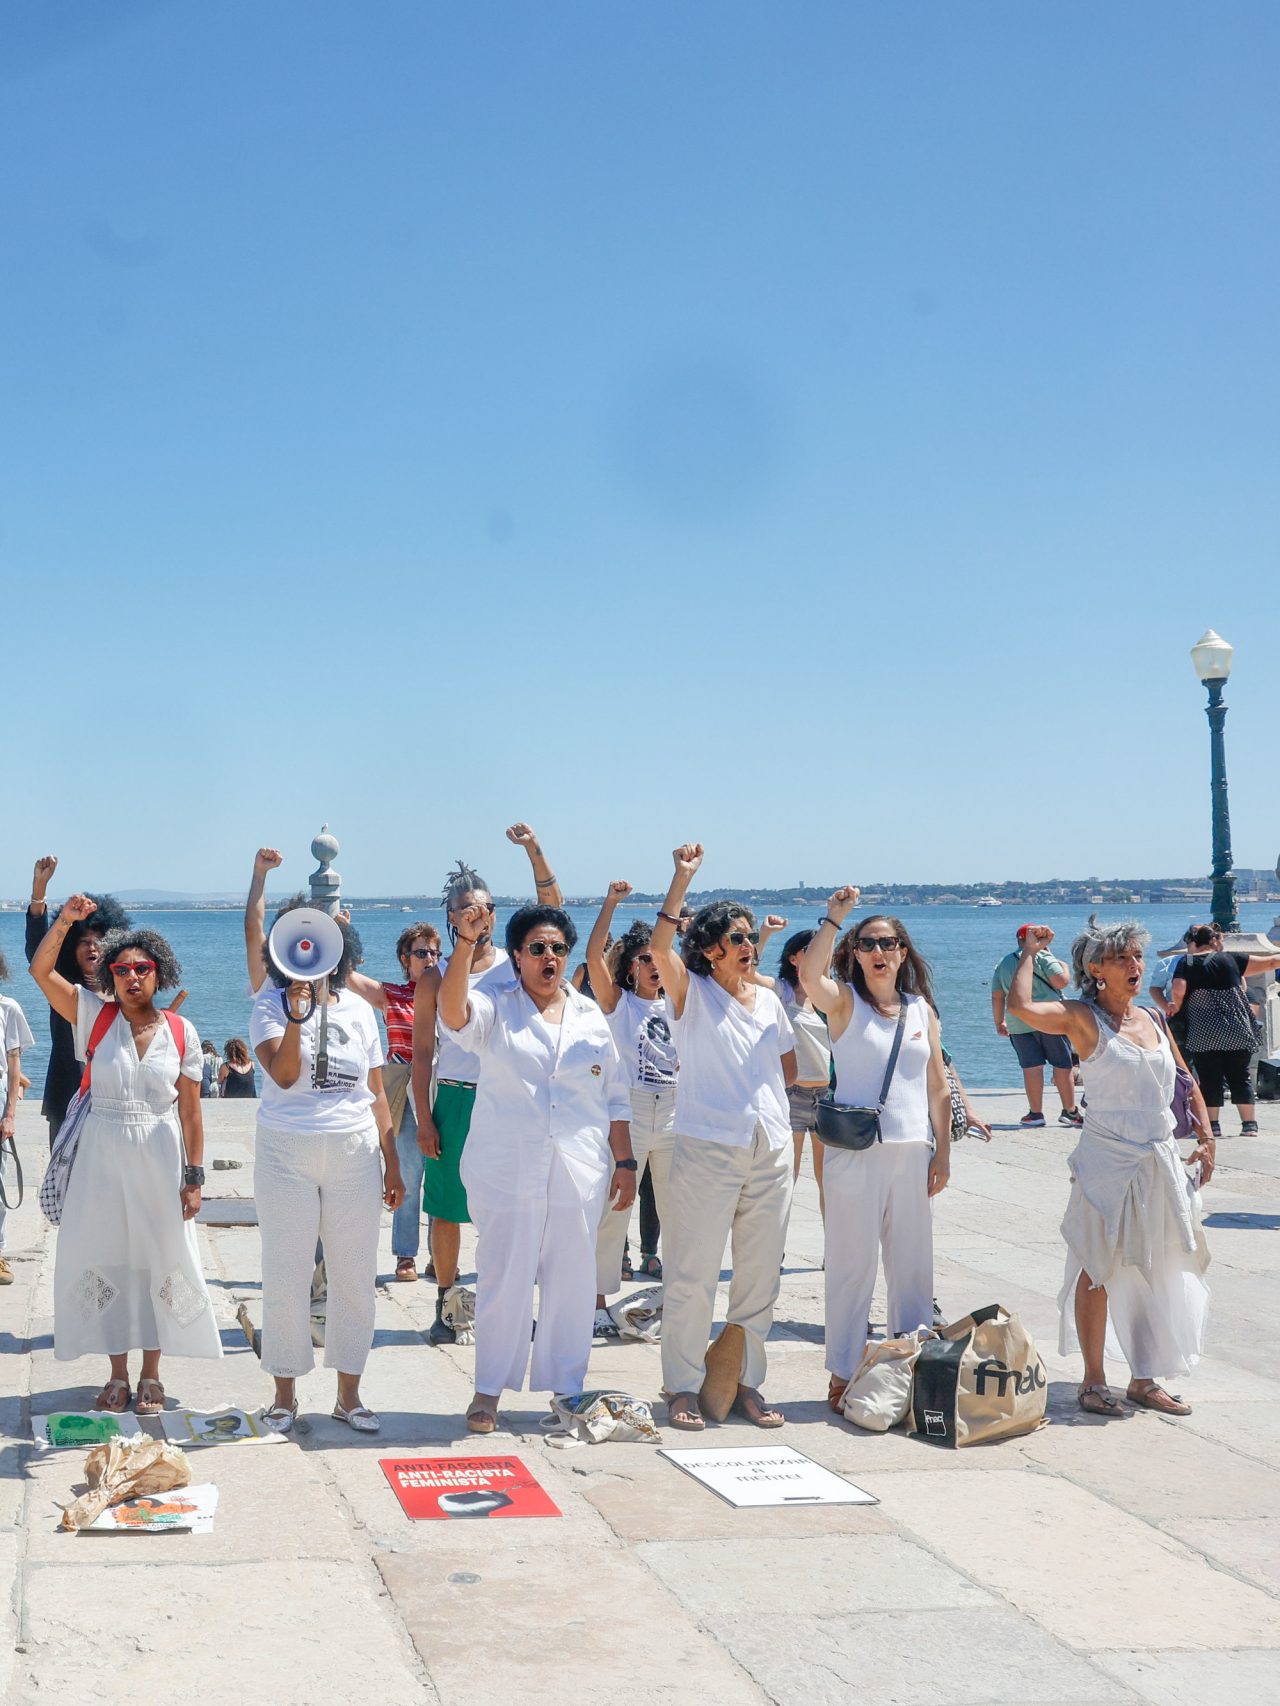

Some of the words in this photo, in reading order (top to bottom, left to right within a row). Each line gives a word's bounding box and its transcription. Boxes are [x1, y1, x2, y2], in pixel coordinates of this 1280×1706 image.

[973, 1359, 1047, 1398] fnac
[393, 1461, 517, 1472] ANTI-FASCISTA
[683, 1458, 813, 1469] DESCOLONIZAR
[398, 1469, 515, 1480] ANTI-RACISTA
[400, 1477, 492, 1488] FEMINISTA
